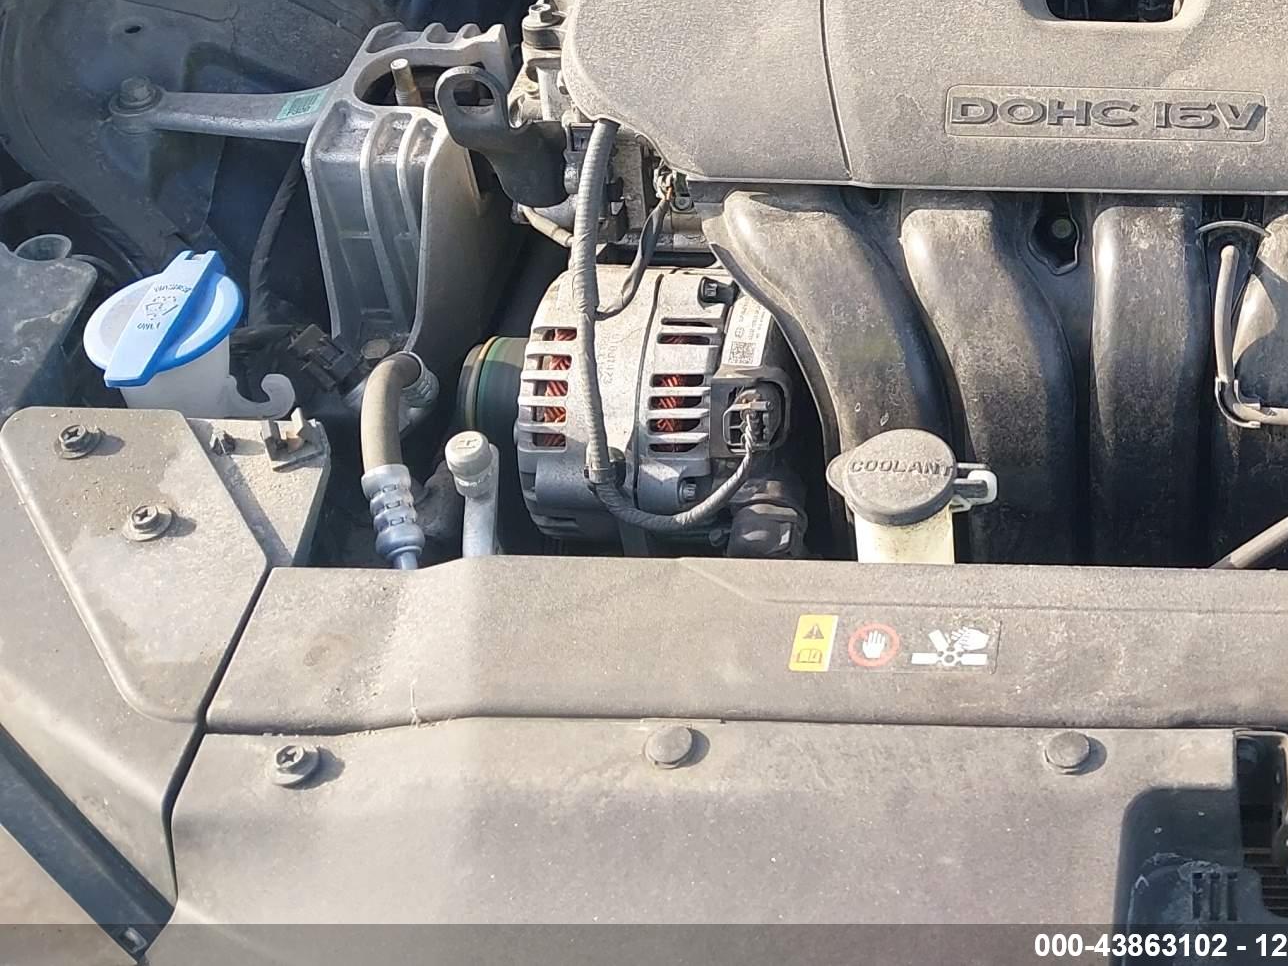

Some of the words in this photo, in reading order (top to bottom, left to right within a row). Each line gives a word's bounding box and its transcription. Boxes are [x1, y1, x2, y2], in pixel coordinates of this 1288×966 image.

[951, 97, 1139, 127] DOHC
[1153, 100, 1267, 131] 16V
[849, 458, 952, 477] COOLANT
